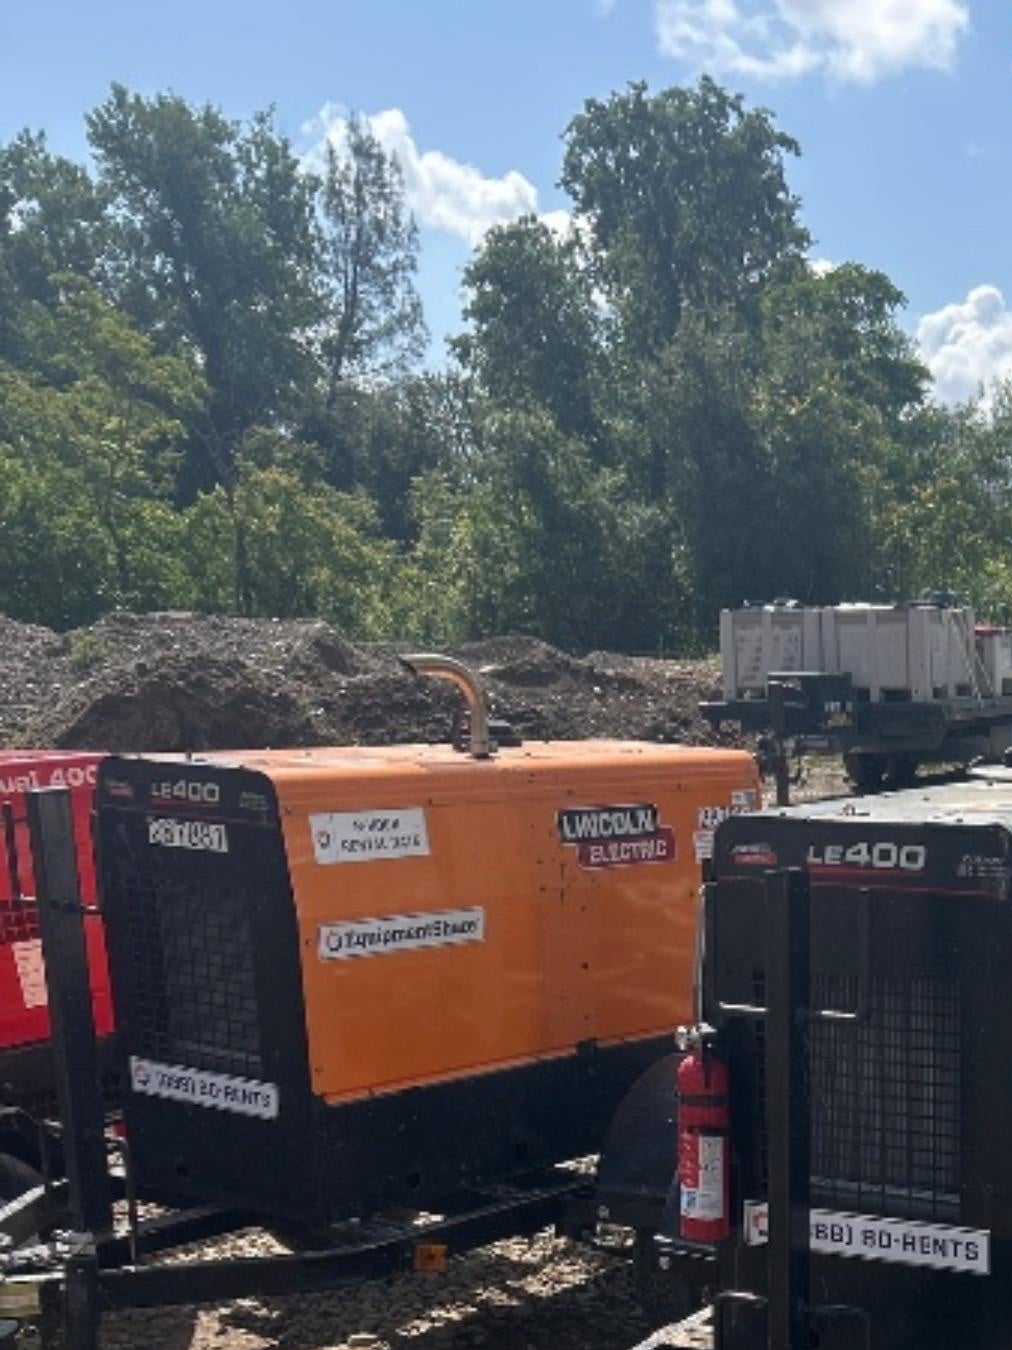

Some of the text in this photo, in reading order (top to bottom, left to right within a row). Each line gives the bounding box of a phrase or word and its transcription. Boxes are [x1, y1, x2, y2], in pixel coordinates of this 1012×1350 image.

[150, 780, 220, 802] LE400
[562, 809, 655, 839] LINCOLN
[589, 839, 667, 864] ELECTRIC
[806, 842, 927, 870] LE400
